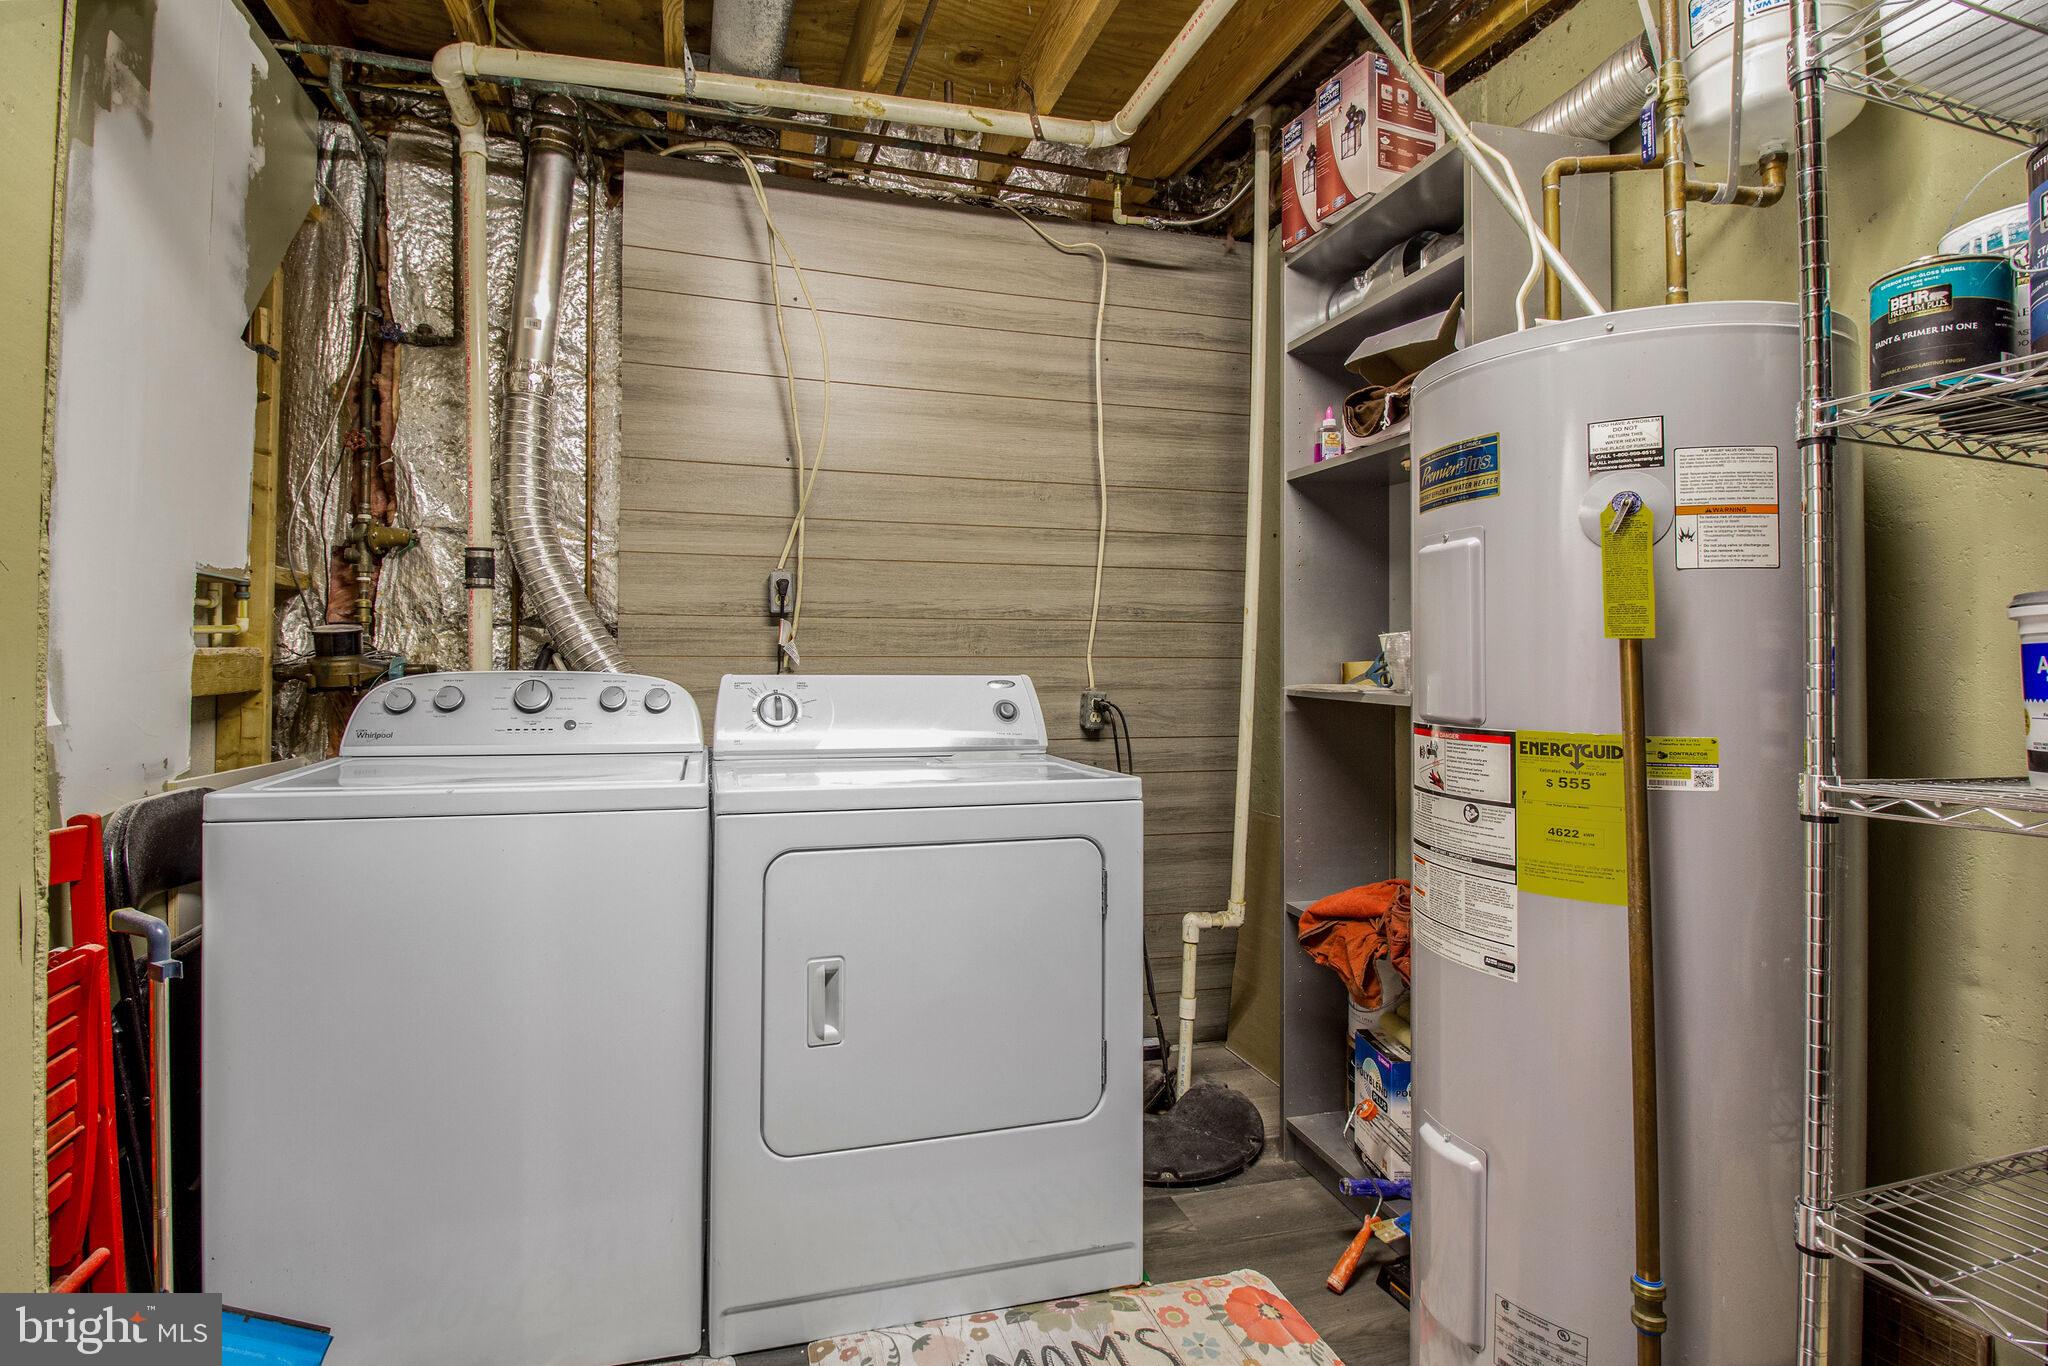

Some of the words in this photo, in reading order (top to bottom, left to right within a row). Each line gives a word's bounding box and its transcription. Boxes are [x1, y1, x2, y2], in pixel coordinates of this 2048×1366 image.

[1880, 278, 1903, 291] EXTERIOR
[1903, 269, 1940, 283] SEMI-GLOSS
[1940, 266, 1966, 274] ENAMEL
[1890, 289, 1930, 312] BEHR
[1890, 303, 1926, 319] PREMIUM
[1902, 326, 1939, 340] PRIMER
[1941, 324, 1953, 332] IN
[1955, 321, 1978, 331] ONE
[1596, 452, 1611, 460] CALL
[1453, 480, 1473, 494] WATER
[1473, 476, 1498, 489] HEATER
[356, 731, 393, 740] Whirlpool
[1439, 731, 1460, 740] DANGER
[1519, 741, 1625, 761] ENERGYGUID
[1546, 778, 1553, 788] $
[1558, 776, 1591, 790] 555
[1548, 827, 1580, 838] 4622
[1356, 1063, 1388, 1099] POLYBLEND
